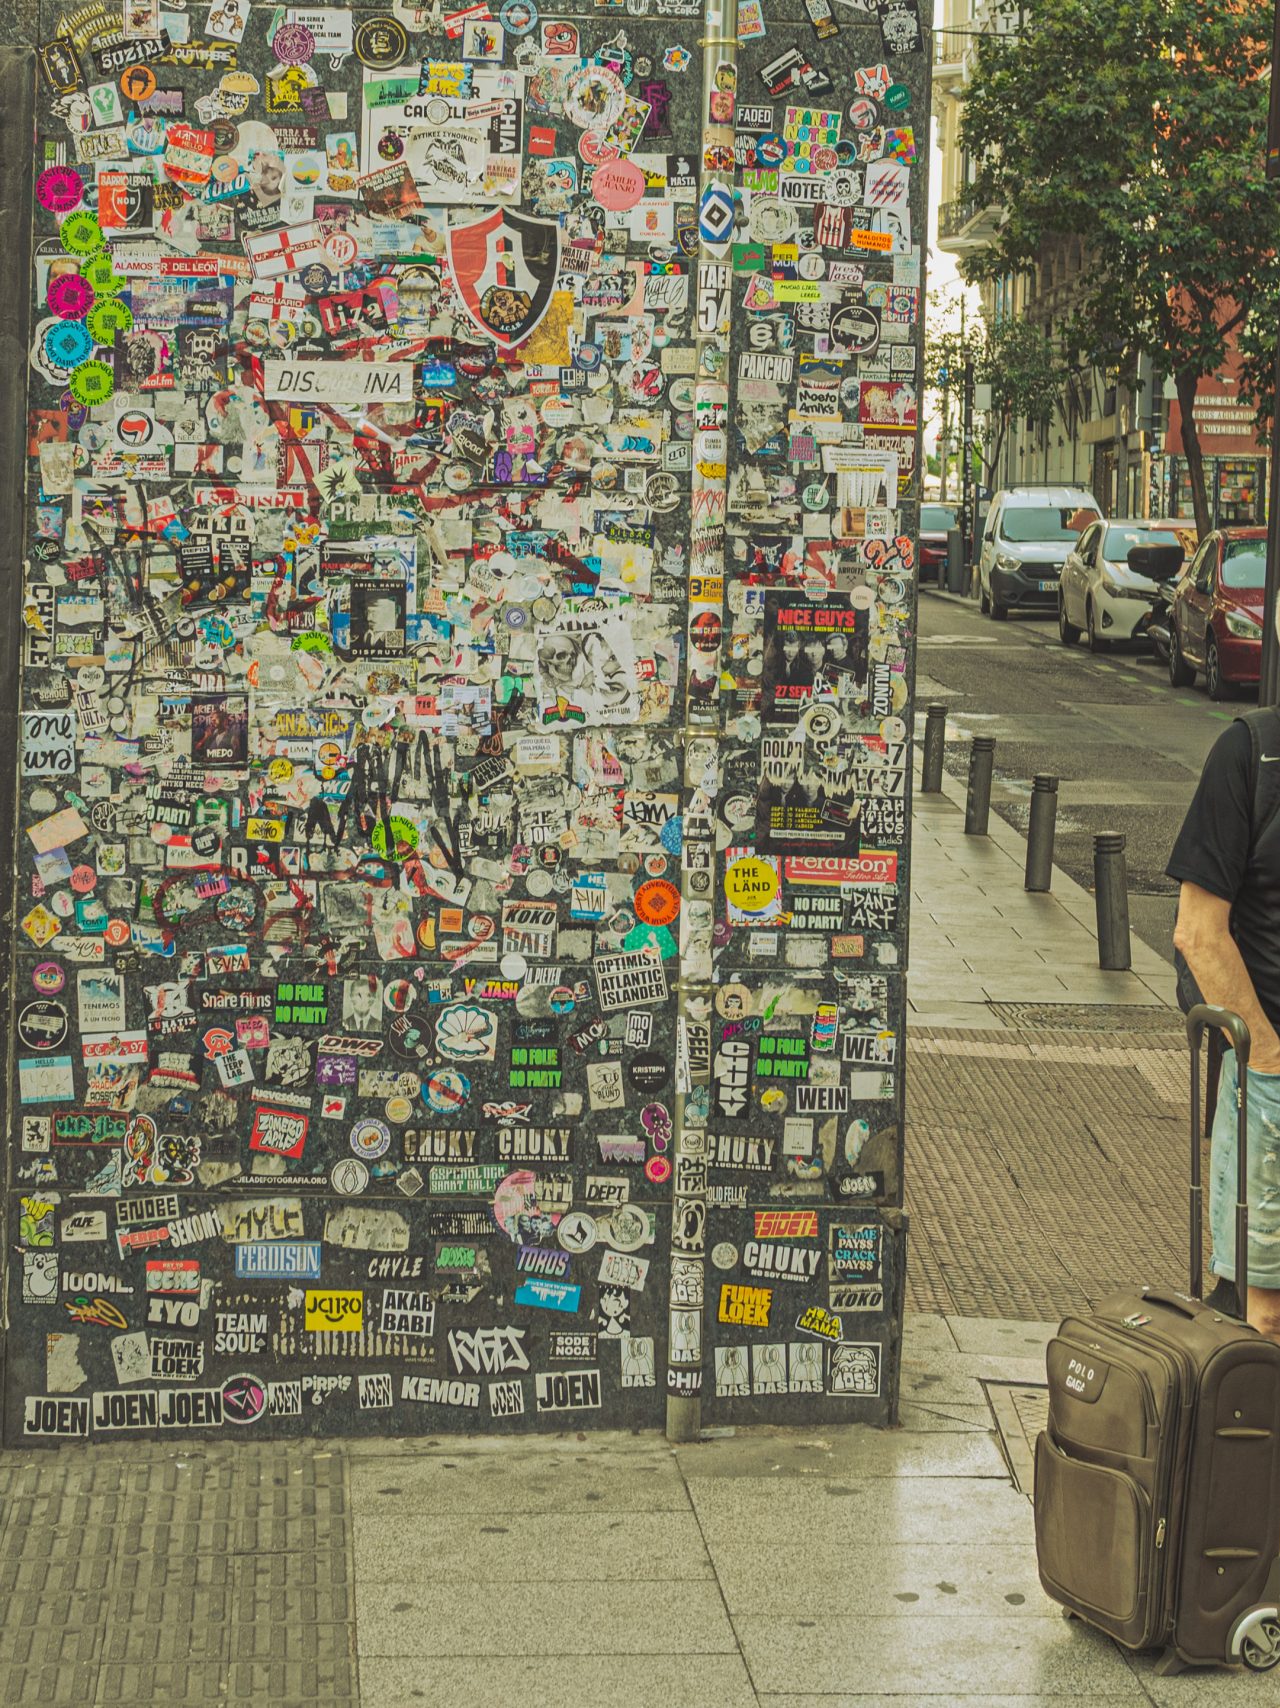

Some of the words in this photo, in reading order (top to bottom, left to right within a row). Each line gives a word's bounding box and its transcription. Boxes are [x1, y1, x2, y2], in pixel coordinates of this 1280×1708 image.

[891, 41, 916, 51] CORE
[739, 107, 772, 123] FADED
[788, 109, 840, 127] TRANSIT
[274, 128, 299, 137] BIRRA
[786, 126, 838, 144] NOTER
[181, 140, 203, 151] HELLO
[101, 175, 127, 187] BARRIO
[127, 175, 153, 187] LEPRA
[826, 169, 847, 190] STREET
[838, 188, 860, 206] ACTION
[855, 240, 893, 250] HUMANOS
[857, 233, 891, 243] MALDITOS
[115, 262, 153, 271] ALAMOS
[172, 262, 191, 272] DEL
[192, 260, 218, 273] LEÓN
[644, 263, 682, 275] POSCA
[324, 303, 383, 330] liza
[888, 312, 908, 322] SPLIT
[740, 355, 791, 382] PANCHO
[799, 390, 838, 403] Moeto
[980, 488, 987, 498] P
[610, 527, 651, 539] BILBAO
[778, 608, 812, 626] NICE
[814, 608, 856, 627] GUYS
[39, 689, 69, 699] SCHOOL
[776, 686, 789, 697] 27
[873, 664, 890, 720] MUÑOZ
[206, 749, 233, 758] MIEDO
[157, 805, 191, 822] PARTY
[733, 868, 760, 880] THE
[638, 878, 680, 899] ADVENTURE
[733, 876, 771, 893] LÄND
[632, 890, 650, 924] WILDEST
[794, 898, 810, 911] NO
[812, 897, 841, 912] FOLIE
[853, 893, 897, 911] DANI
[505, 909, 556, 924] KOKO
[790, 914, 809, 929] NO
[810, 913, 843, 929] PARTY
[851, 910, 895, 930] ART
[600, 969, 663, 991] ATLANTIC
[202, 991, 238, 1008] Snare
[278, 984, 293, 1001] NO
[295, 984, 325, 1001] FOLIE
[601, 984, 665, 1006] ISLANDER
[84, 1002, 121, 1010] TENEMOS
[276, 1006, 292, 1023] NO
[294, 1006, 328, 1024] PARTY
[760, 1037, 775, 1054] NO
[776, 1038, 806, 1056] FOLIE
[222, 1056, 236, 1064] THE
[511, 1048, 527, 1065] NO
[529, 1048, 558, 1065] FOLIE
[757, 1059, 773, 1076] NO
[774, 1059, 809, 1078] PARTY
[510, 1071, 527, 1087] NO
[528, 1070, 562, 1088] PARTY
[720, 1041, 750, 1117] CHUKY
[798, 1088, 847, 1111] WEIN
[404, 1129, 477, 1157] CHUKY
[499, 1128, 570, 1156] CHUKY
[447, 1156, 475, 1164] SIGUE
[838, 1239, 874, 1250] PAY$$
[238, 1244, 321, 1272] FERDISON
[743, 1242, 821, 1276] CHUKY
[835, 1250, 876, 1261] CRACK
[367, 1256, 422, 1278] CHYLE
[836, 1260, 873, 1271] DAY$$
[765, 1271, 780, 1279] SOY
[782, 1274, 810, 1283] CHUKY
[384, 1291, 434, 1312] AKAB
[723, 1284, 773, 1304] FUME
[833, 1292, 882, 1308] KOKO
[719, 1301, 769, 1324] LOEK
[806, 1307, 840, 1328] HOLA
[215, 1313, 268, 1333] TEAM
[383, 1313, 432, 1335] BABI
[799, 1317, 839, 1338] MAMA
[152, 1340, 201, 1358] FUME
[214, 1332, 259, 1353] SOUL
[556, 1336, 590, 1347] SODE
[555, 1346, 591, 1356] NOCA
[151, 1357, 201, 1375] LOEK
[1068, 1358, 1095, 1381] POLO
[622, 1374, 656, 1387] DAS
[754, 1381, 788, 1394] DAS
[789, 1381, 824, 1393] DAS
[360, 1381, 392, 1408] JOEN
[400, 1376, 480, 1408] KEMOR
[492, 1385, 523, 1414] JOEN
[539, 1372, 600, 1410] JOEN
[716, 1384, 750, 1397] DAS
[26, 1400, 89, 1434] JOEN
[96, 1393, 157, 1427] JOEN
[161, 1391, 223, 1427] JOEN
